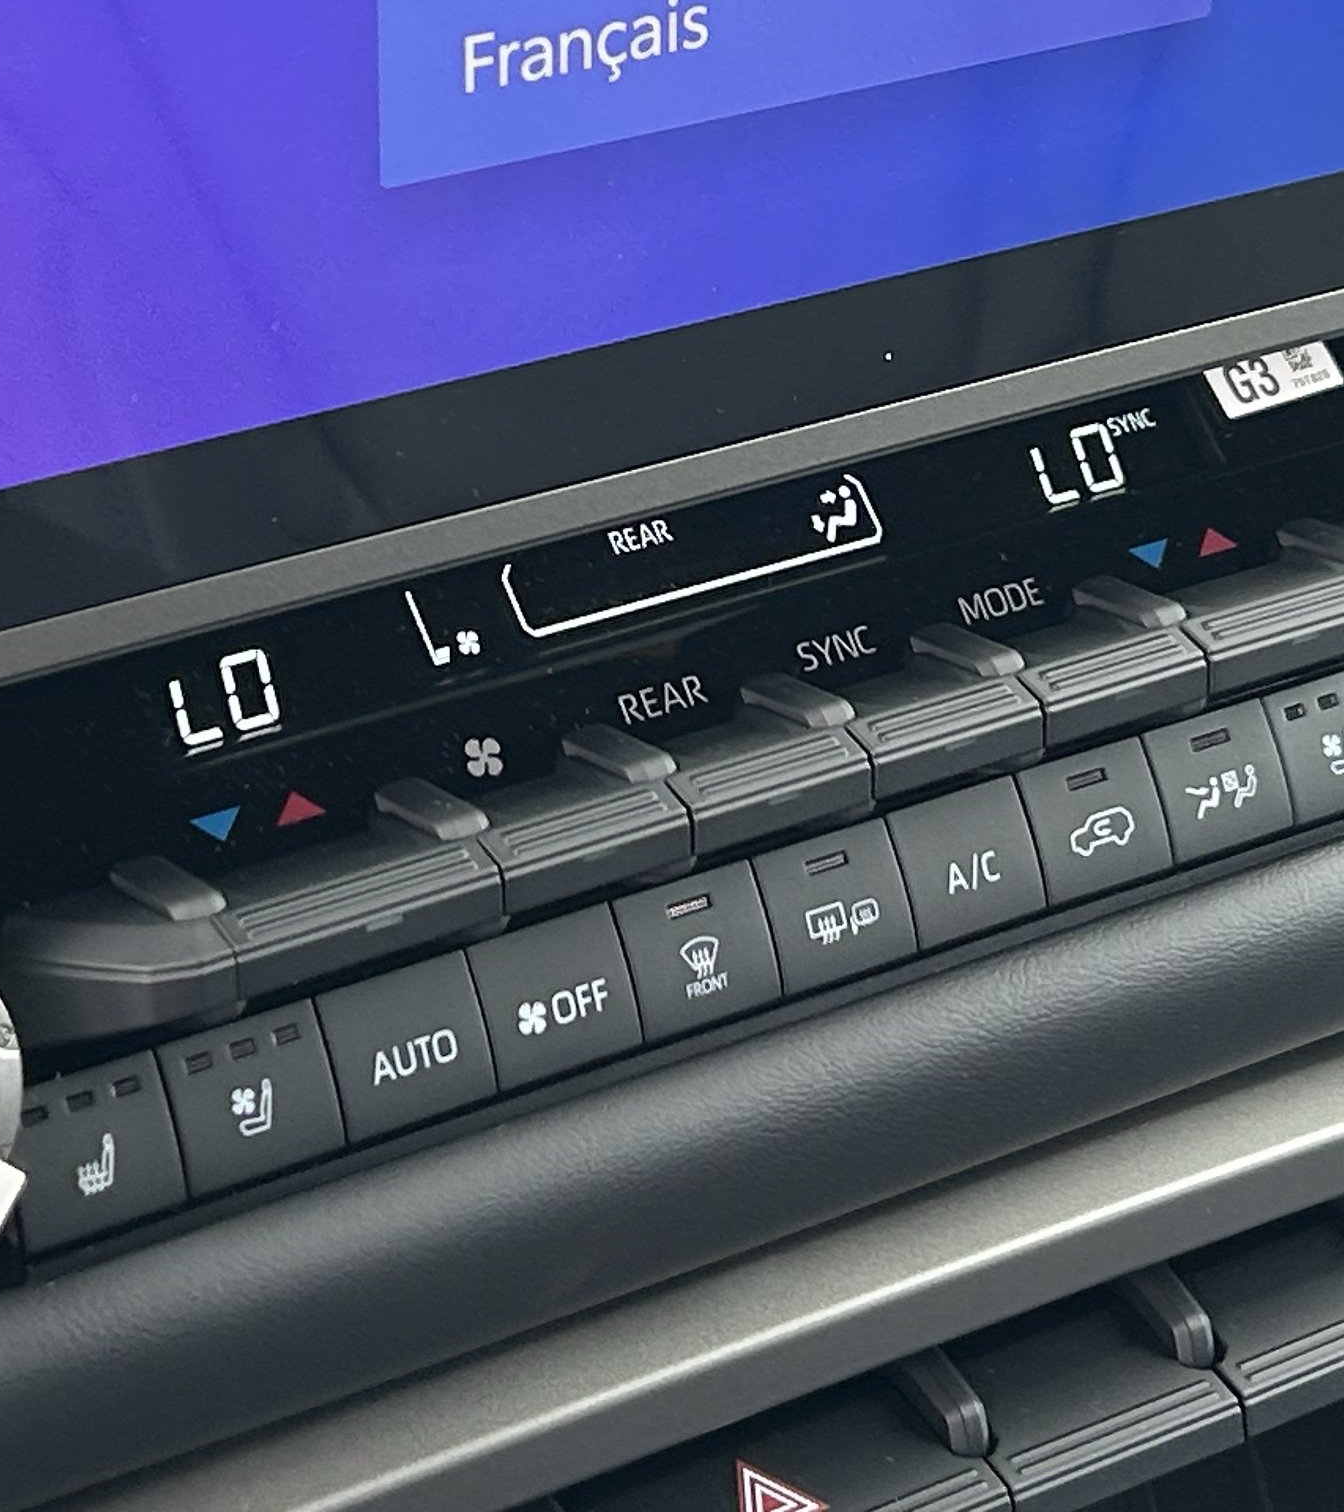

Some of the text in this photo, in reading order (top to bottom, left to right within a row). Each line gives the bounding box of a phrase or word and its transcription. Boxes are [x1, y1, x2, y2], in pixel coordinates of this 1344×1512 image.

[1224, 357, 1280, 404] G3
[1106, 407, 1157, 437] SYNC
[607, 519, 674, 556] REAR
[958, 577, 1045, 626] MODE
[797, 624, 878, 672] SYNC
[619, 675, 709, 725] REAR
[947, 850, 1002, 894] A/C
[552, 978, 609, 1026] OFF
[685, 971, 729, 1000] FRONT
[372, 1028, 458, 1086] AUTO
